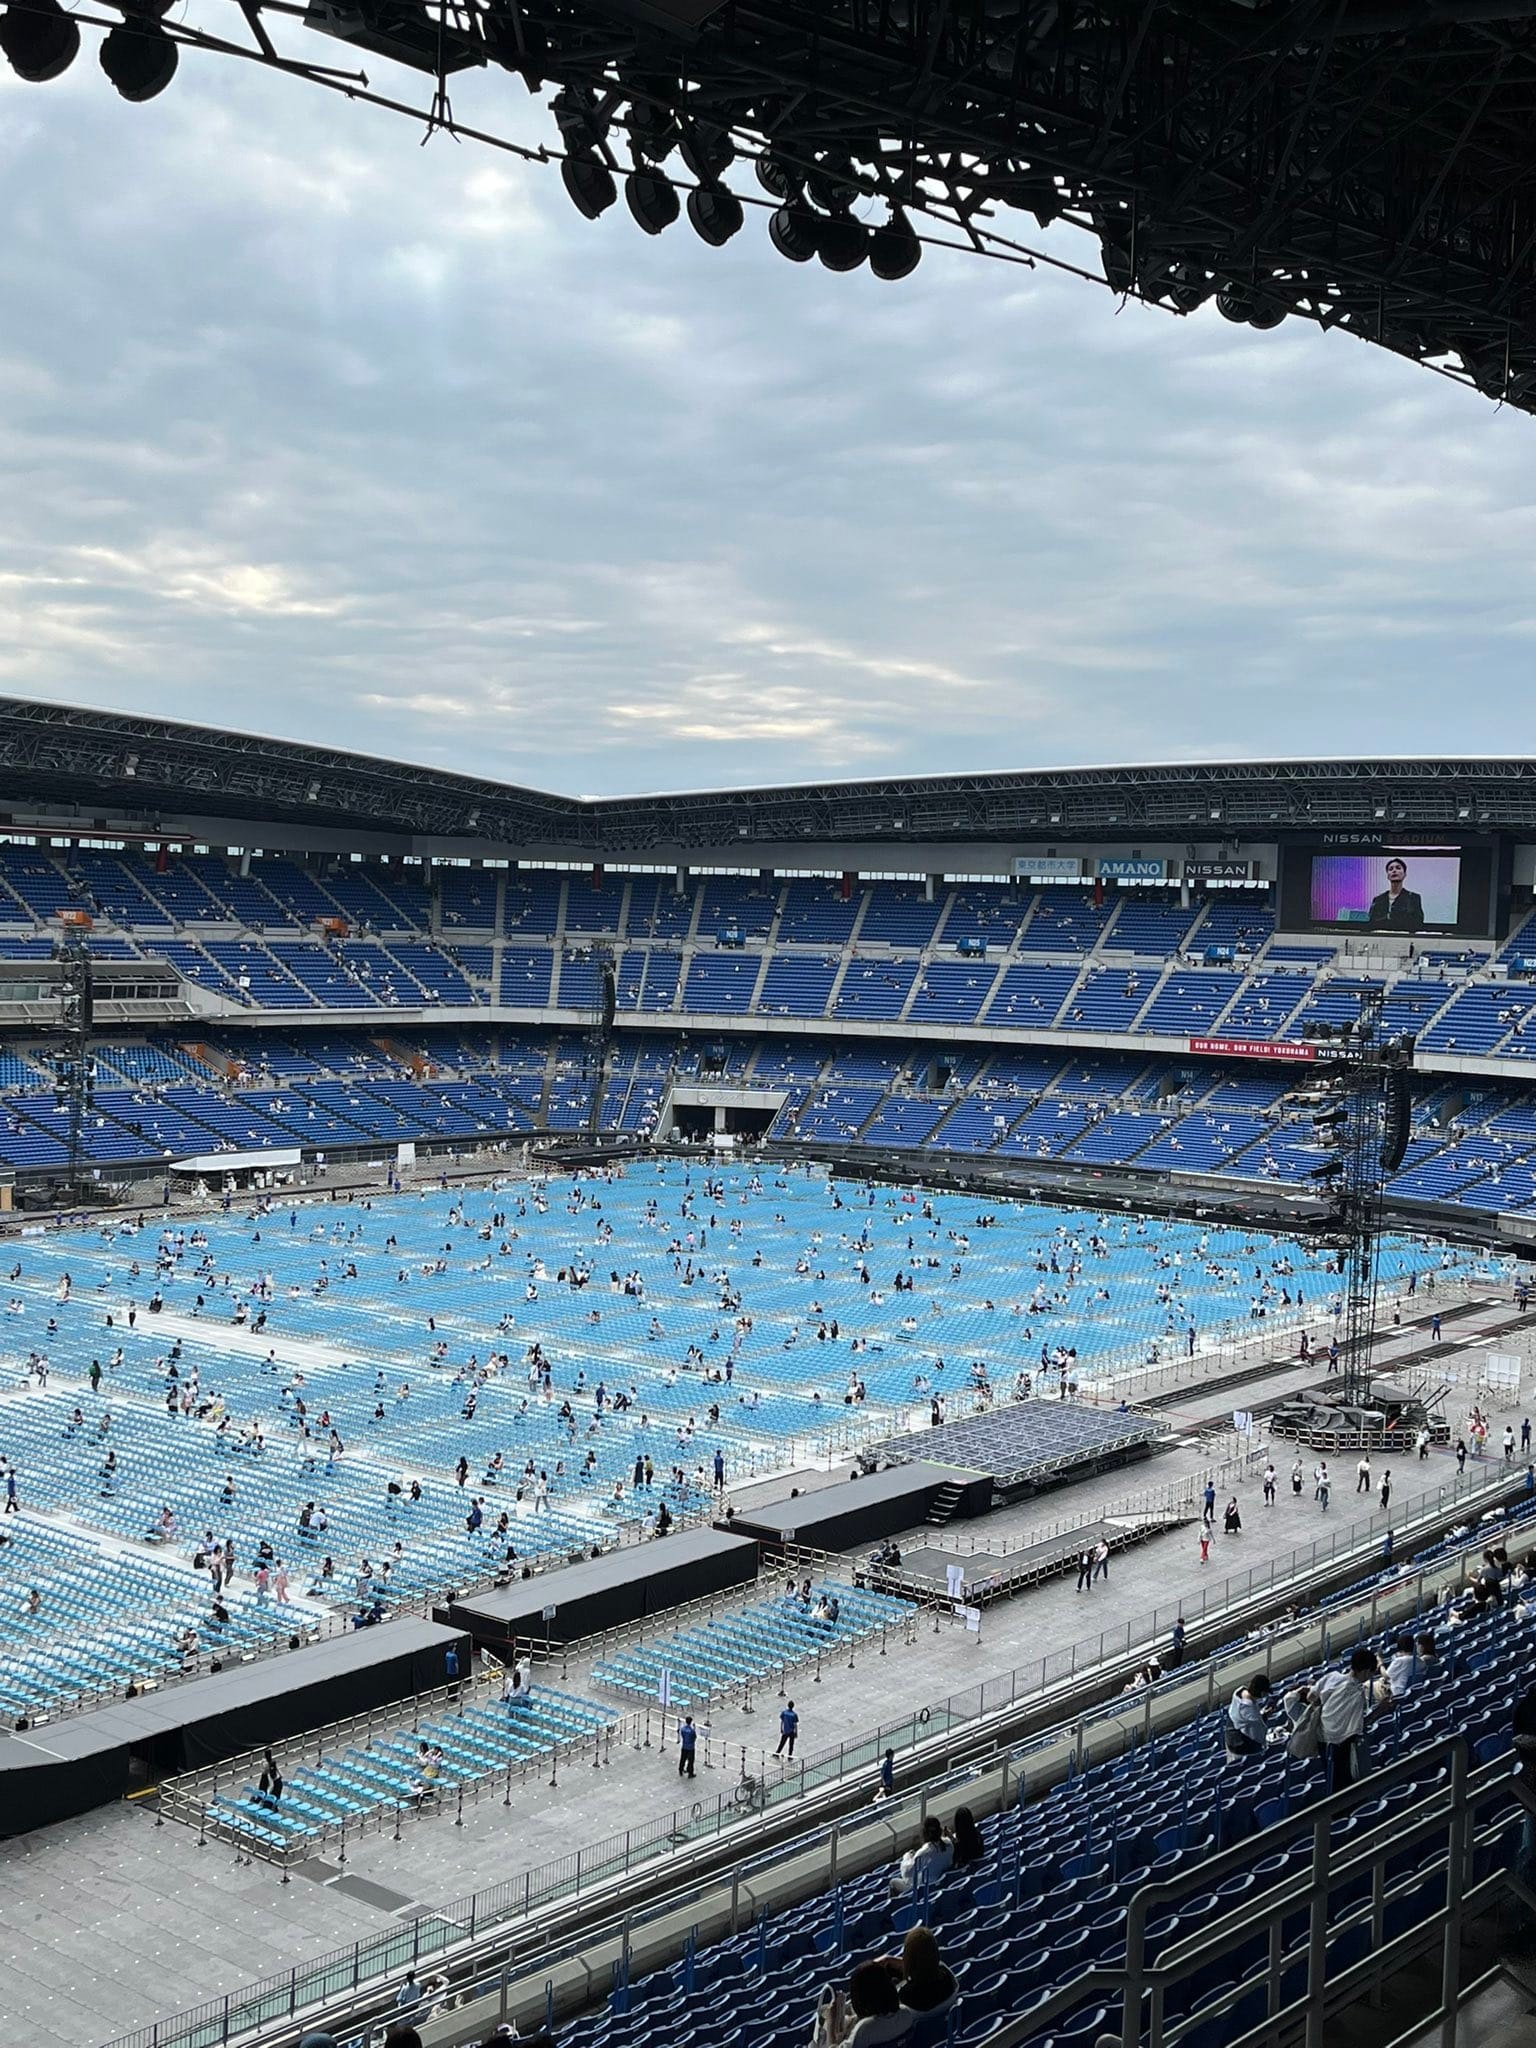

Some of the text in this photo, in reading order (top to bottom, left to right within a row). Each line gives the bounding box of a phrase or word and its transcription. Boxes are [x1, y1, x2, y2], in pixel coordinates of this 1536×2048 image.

[1323, 834, 1382, 843] NISSAN
[1100, 863, 1160, 875] AMANO
[1186, 866, 1246, 875] NISSAN
[1234, 1044, 1247, 1052] OUR
[1274, 1046, 1309, 1056] YOKOHAMA
[1318, 1049, 1363, 1060] NISSAN
